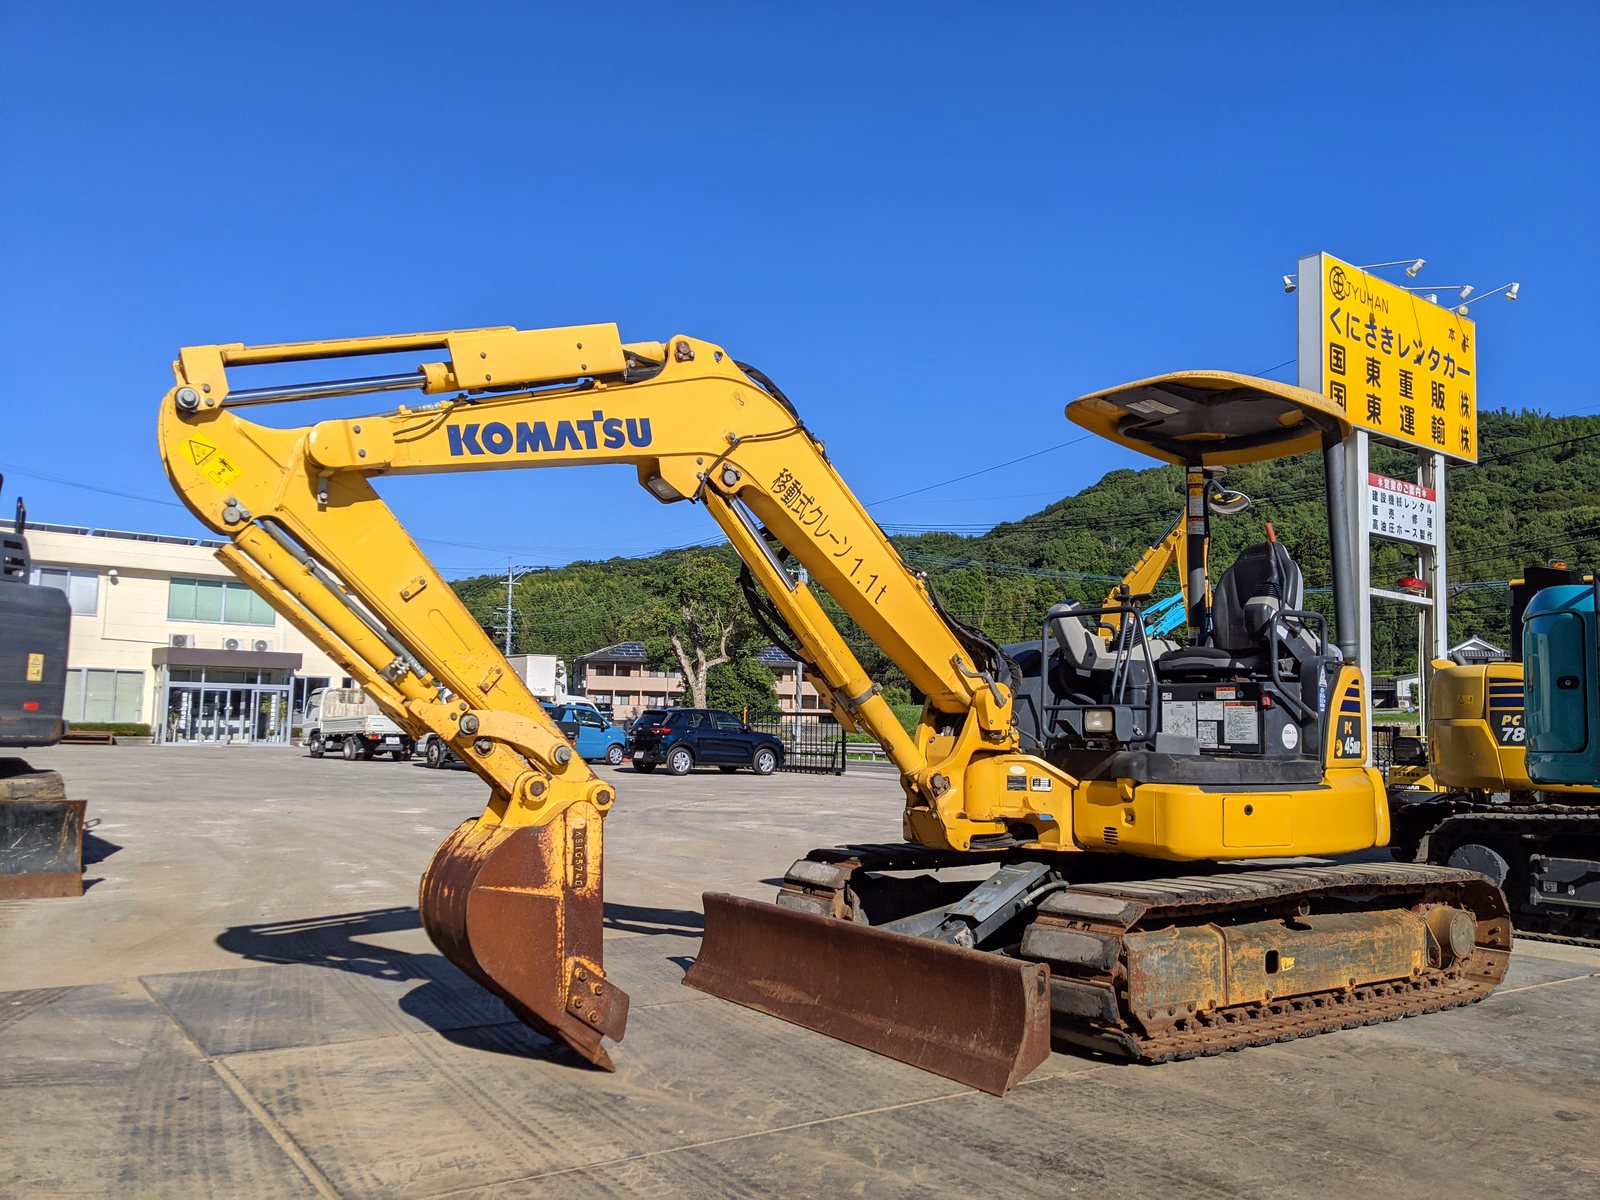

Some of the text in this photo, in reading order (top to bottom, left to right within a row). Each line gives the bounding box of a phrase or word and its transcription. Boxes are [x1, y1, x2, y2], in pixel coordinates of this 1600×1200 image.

[1344, 281, 1388, 314] JYUHAN
[1330, 307, 1470, 379] くにさきレンタカー
[446, 410, 652, 456] KOMATSU
[1344, 721, 1353, 735] PC
[1501, 714, 1521, 726] PC
[1501, 727, 1526, 742] 78
